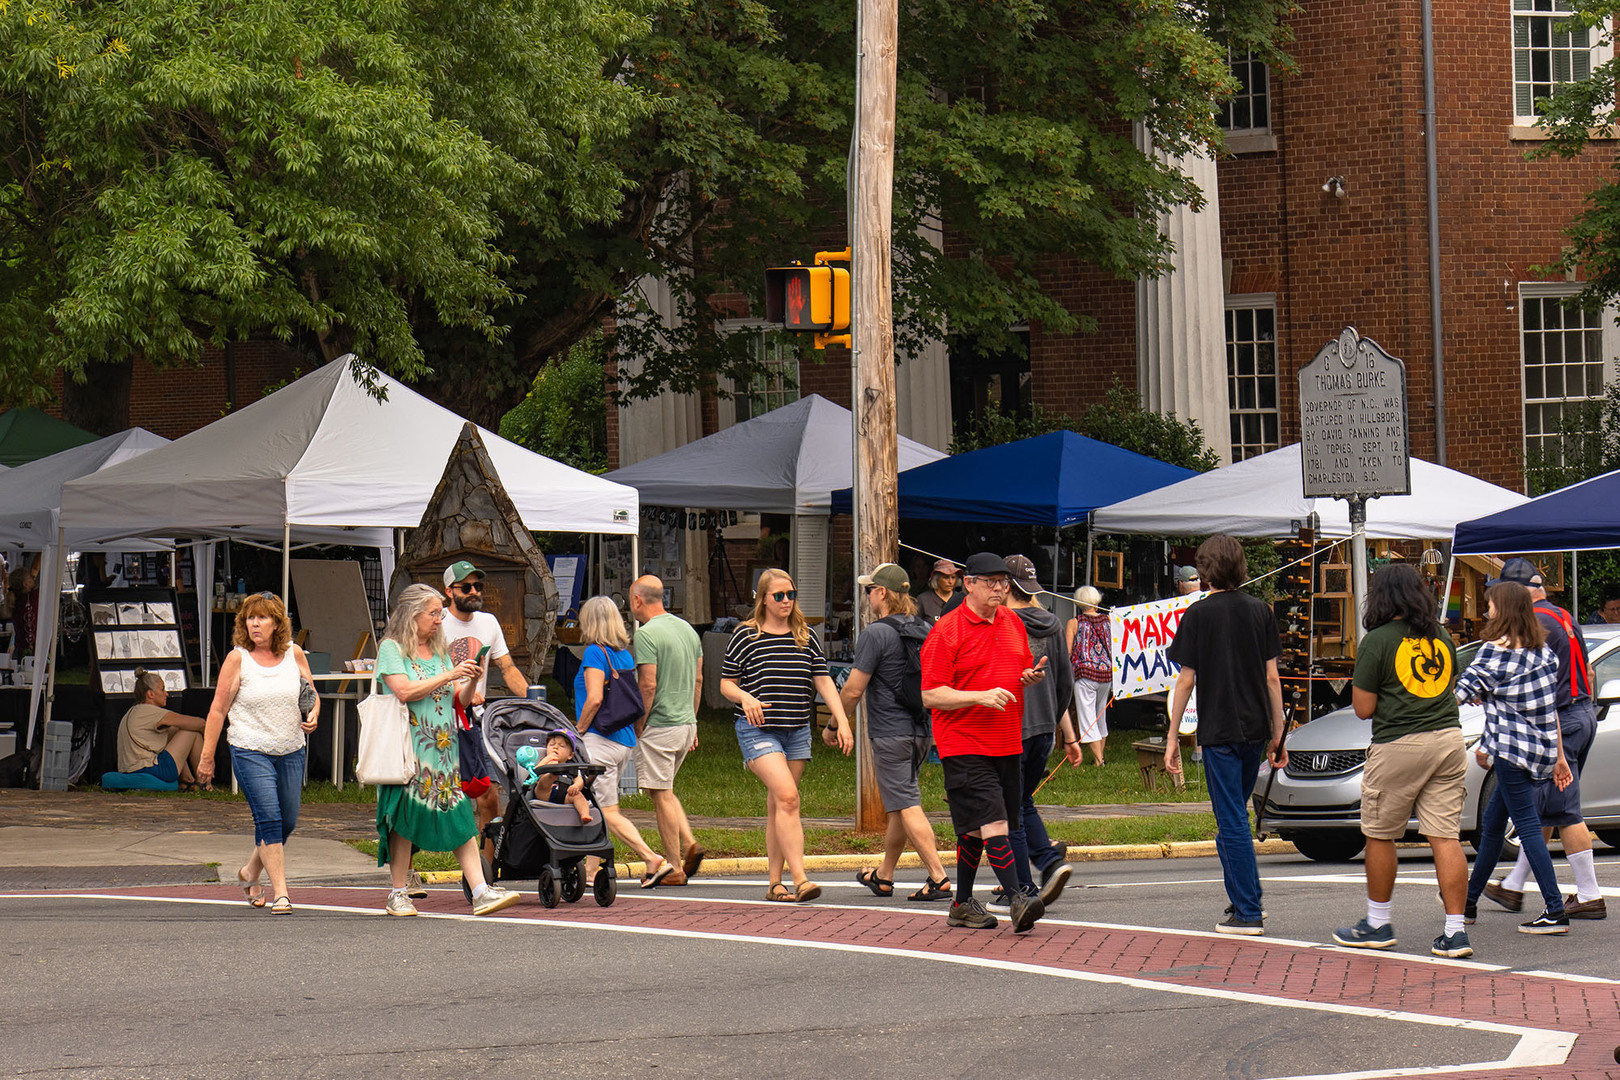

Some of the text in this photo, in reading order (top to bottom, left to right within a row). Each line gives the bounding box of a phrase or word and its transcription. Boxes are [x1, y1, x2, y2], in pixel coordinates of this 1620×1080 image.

[1324, 352, 1376, 371] G 16
[1315, 371, 1387, 391] THOMAS BURKE
[1305, 400, 1342, 412] GOVERNOR
[1347, 399, 1356, 410] OF
[1383, 397, 1399, 408] WAS
[1305, 412, 1400, 427] CAPTURED IN HILLSBORO
[1306, 426, 1401, 441] BY DAVID FANNING AND
[1306, 444, 1319, 456] HIS
[1362, 441, 1385, 453] SEPT.
[1334, 457, 1349, 469] AND
[1358, 456, 1382, 468] TAKEN
[1392, 455, 1402, 466] TO
[1363, 471, 1379, 482] S.C.
